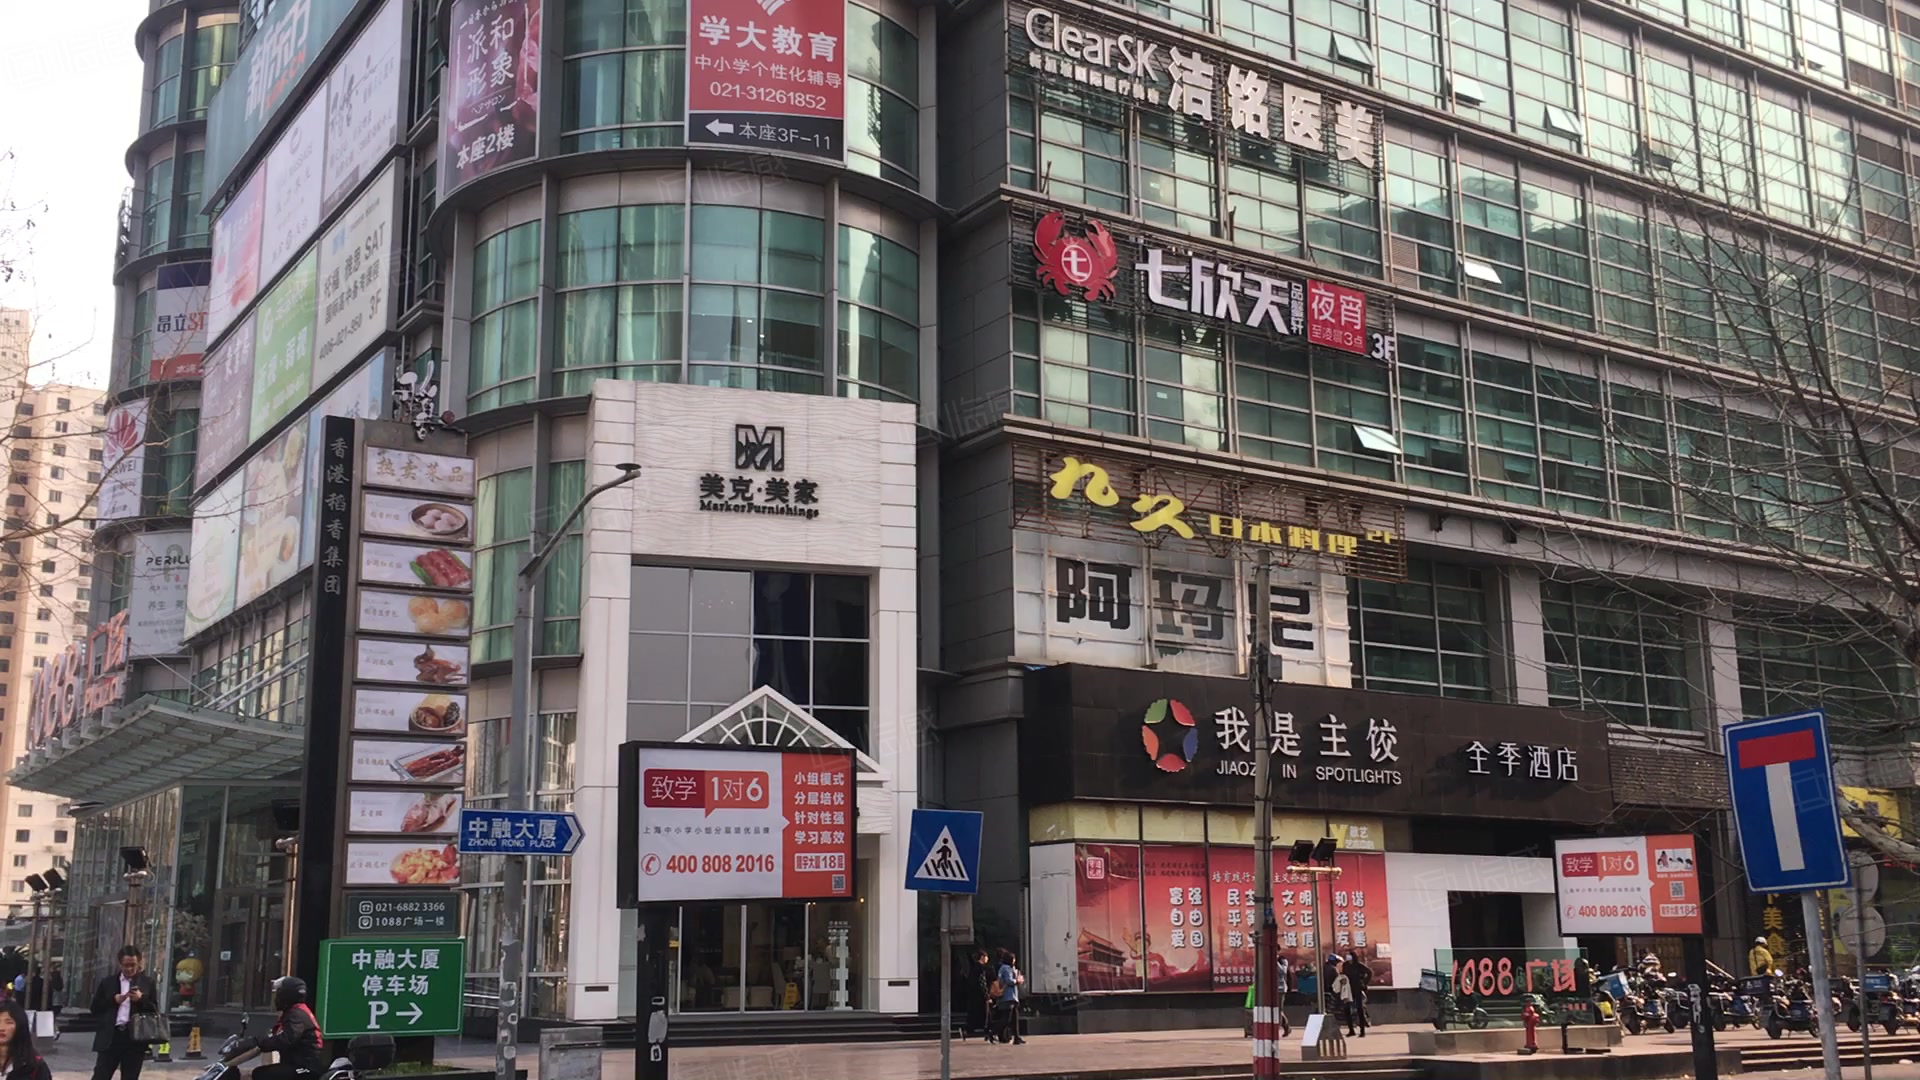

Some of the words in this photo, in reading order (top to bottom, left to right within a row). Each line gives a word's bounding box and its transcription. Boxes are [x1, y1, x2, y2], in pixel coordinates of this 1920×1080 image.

[699, 15, 838, 62] 学大教育
[1026, 8, 1159, 82] ClearSK
[694, 54, 842, 89] 中小学个性化辅导
[710, 81, 826, 111] 021-31261852
[456, 124, 515, 169] 本座2楼
[739, 122, 831, 150] 本座3F-11
[364, 221, 386, 262] SAT
[368, 288, 382, 320] 3F
[1135, 248, 1290, 335] 七欣天
[1312, 282, 1361, 330] 夜宵
[1371, 333, 1396, 361] 3F
[376, 456, 464, 483] 热卖菜品
[322, 437, 350, 595] 香港稻香集团
[1209, 514, 1357, 557] 日本料理
[1214, 706, 1399, 763] 我是主饺
[1465, 741, 1579, 782] 全季酒店
[794, 772, 845, 786] 小组模式
[1216, 761, 1257, 778] JIAOZ
[1282, 763, 1297, 779] IN
[1315, 766, 1403, 785] SPOTLIGHTS
[651, 776, 697, 801] 致学
[711, 776, 763, 802] 1对6
[794, 791, 845, 805] 分层培优
[468, 817, 557, 840] 中融大厦
[794, 811, 845, 825] 针对性强
[468, 838, 497, 847] ZHONG
[501, 839, 525, 847] RONG
[529, 840, 556, 848] PLAZA
[794, 831, 845, 845] 学习高效
[666, 854, 698, 873] 400
[702, 854, 732, 873] 808
[735, 854, 775, 873] 2016
[1566, 857, 1593, 873] 致学
[1601, 855, 1635, 872] 1对6
[375, 902, 421, 912] 021-6882
[422, 901, 446, 912] 3366
[1169, 887, 1202, 905] 富强
[1227, 889, 1255, 905] 民主
[1281, 890, 1312, 905] 文明
[1335, 891, 1364, 907] 和谐
[375, 916, 445, 927] 1088广场一楼
[1170, 908, 1203, 926] 自由
[1282, 911, 1313, 926] 公正
[1336, 911, 1365, 927] 法治
[1578, 905, 1597, 917] 400
[1600, 905, 1618, 917] 808
[1621, 905, 1646, 917] 2016
[1171, 929, 1204, 948] 爱国
[1284, 931, 1314, 947] 诚信
[1336, 931, 1366, 947] 友善
[351, 948, 441, 971] 中融大厦
[362, 974, 430, 996] 停车场
[1452, 957, 1514, 996] 1088
[1525, 958, 1577, 993] 广场
[367, 1001, 389, 1029] P
